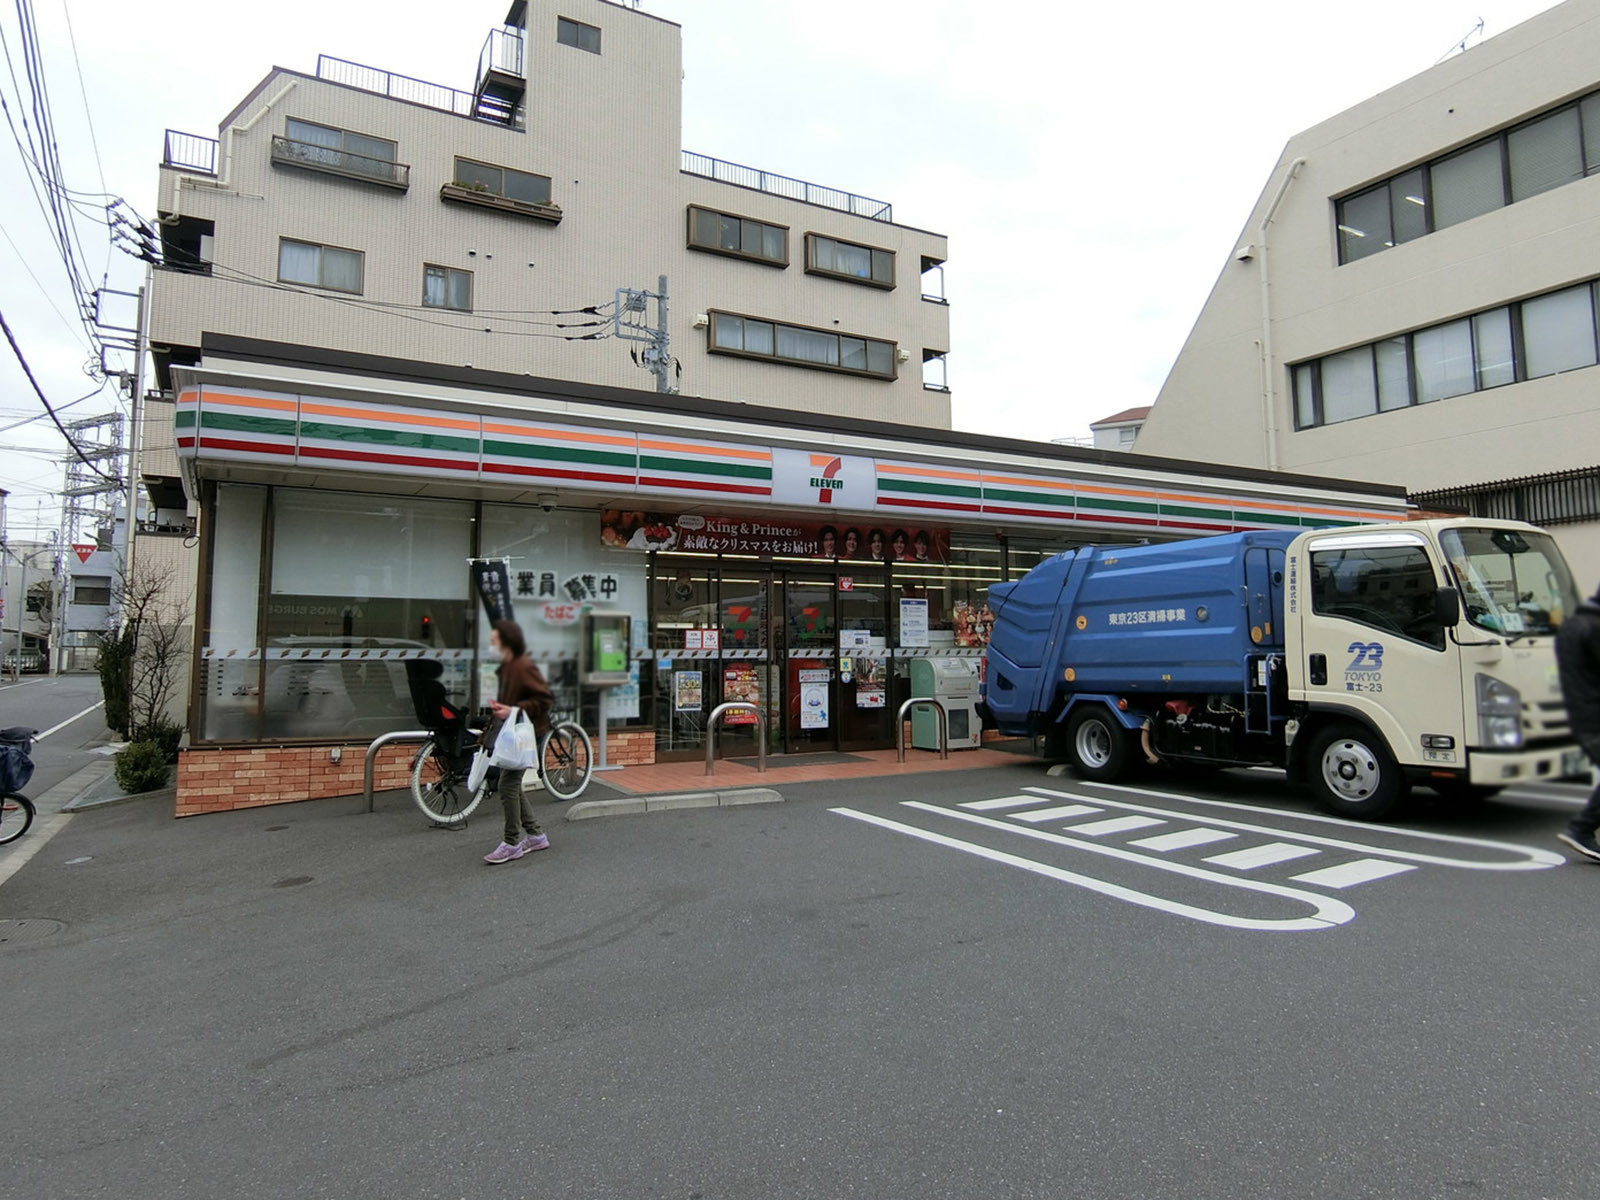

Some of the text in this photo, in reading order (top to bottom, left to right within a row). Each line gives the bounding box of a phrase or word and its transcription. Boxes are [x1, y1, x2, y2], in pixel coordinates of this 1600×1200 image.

[706, 521, 739, 536] King
[740, 522, 750, 534] &
[543, 604, 575, 620] たばこ
[1345, 641, 1384, 671] 23
[1344, 672, 1381, 681] TOKYO
